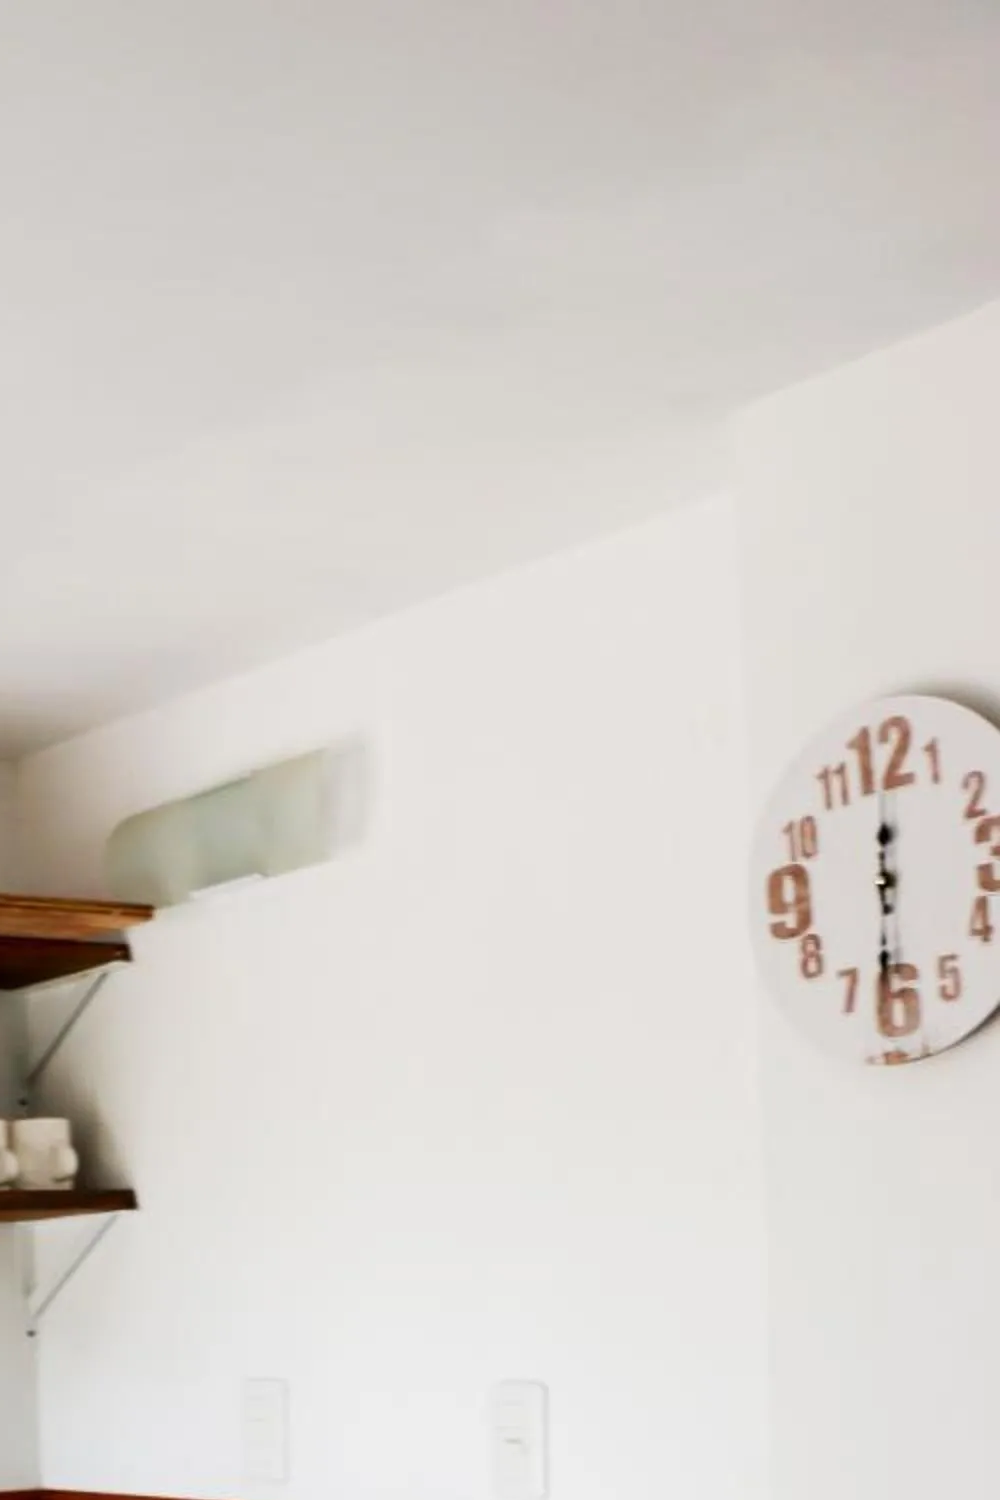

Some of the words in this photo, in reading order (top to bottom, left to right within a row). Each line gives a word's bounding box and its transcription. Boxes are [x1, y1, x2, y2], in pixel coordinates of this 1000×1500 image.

[846, 714, 916, 796] 12
[922, 737, 941, 784] 1
[815, 762, 850, 810] 11
[962, 770, 989, 820] 2
[781, 815, 818, 862] 10
[766, 863, 812, 940] 9
[968, 895, 993, 942] 4
[800, 933, 824, 979] 8
[936, 953, 962, 1001] 5
[837, 967, 859, 1014] 7
[875, 962, 921, 1038] 6
